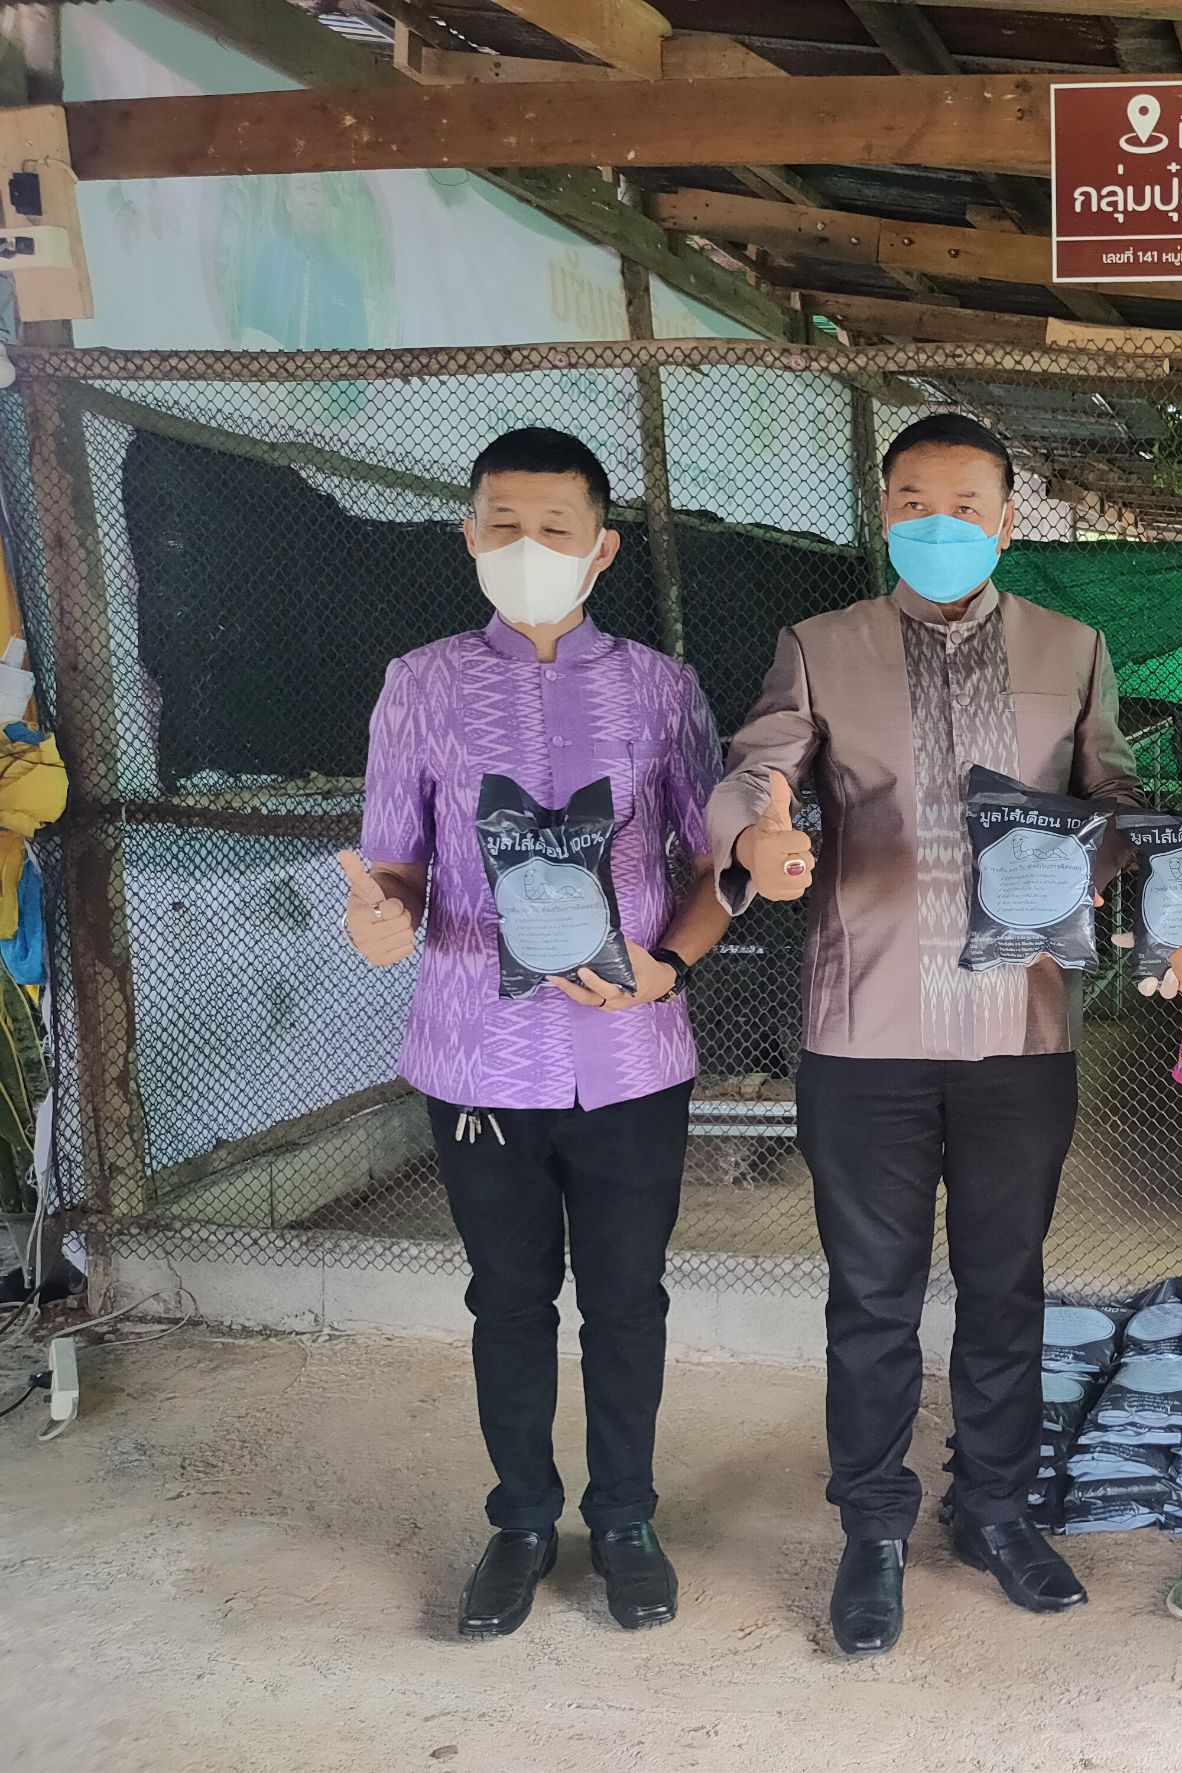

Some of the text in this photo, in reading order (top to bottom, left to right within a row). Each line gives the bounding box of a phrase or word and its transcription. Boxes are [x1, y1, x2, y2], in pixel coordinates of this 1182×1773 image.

[1102, 246, 1134, 264] เลขที่
[1137, 251, 1158, 263] 141
[979, 807, 1061, 828] มูลไส้เดือน
